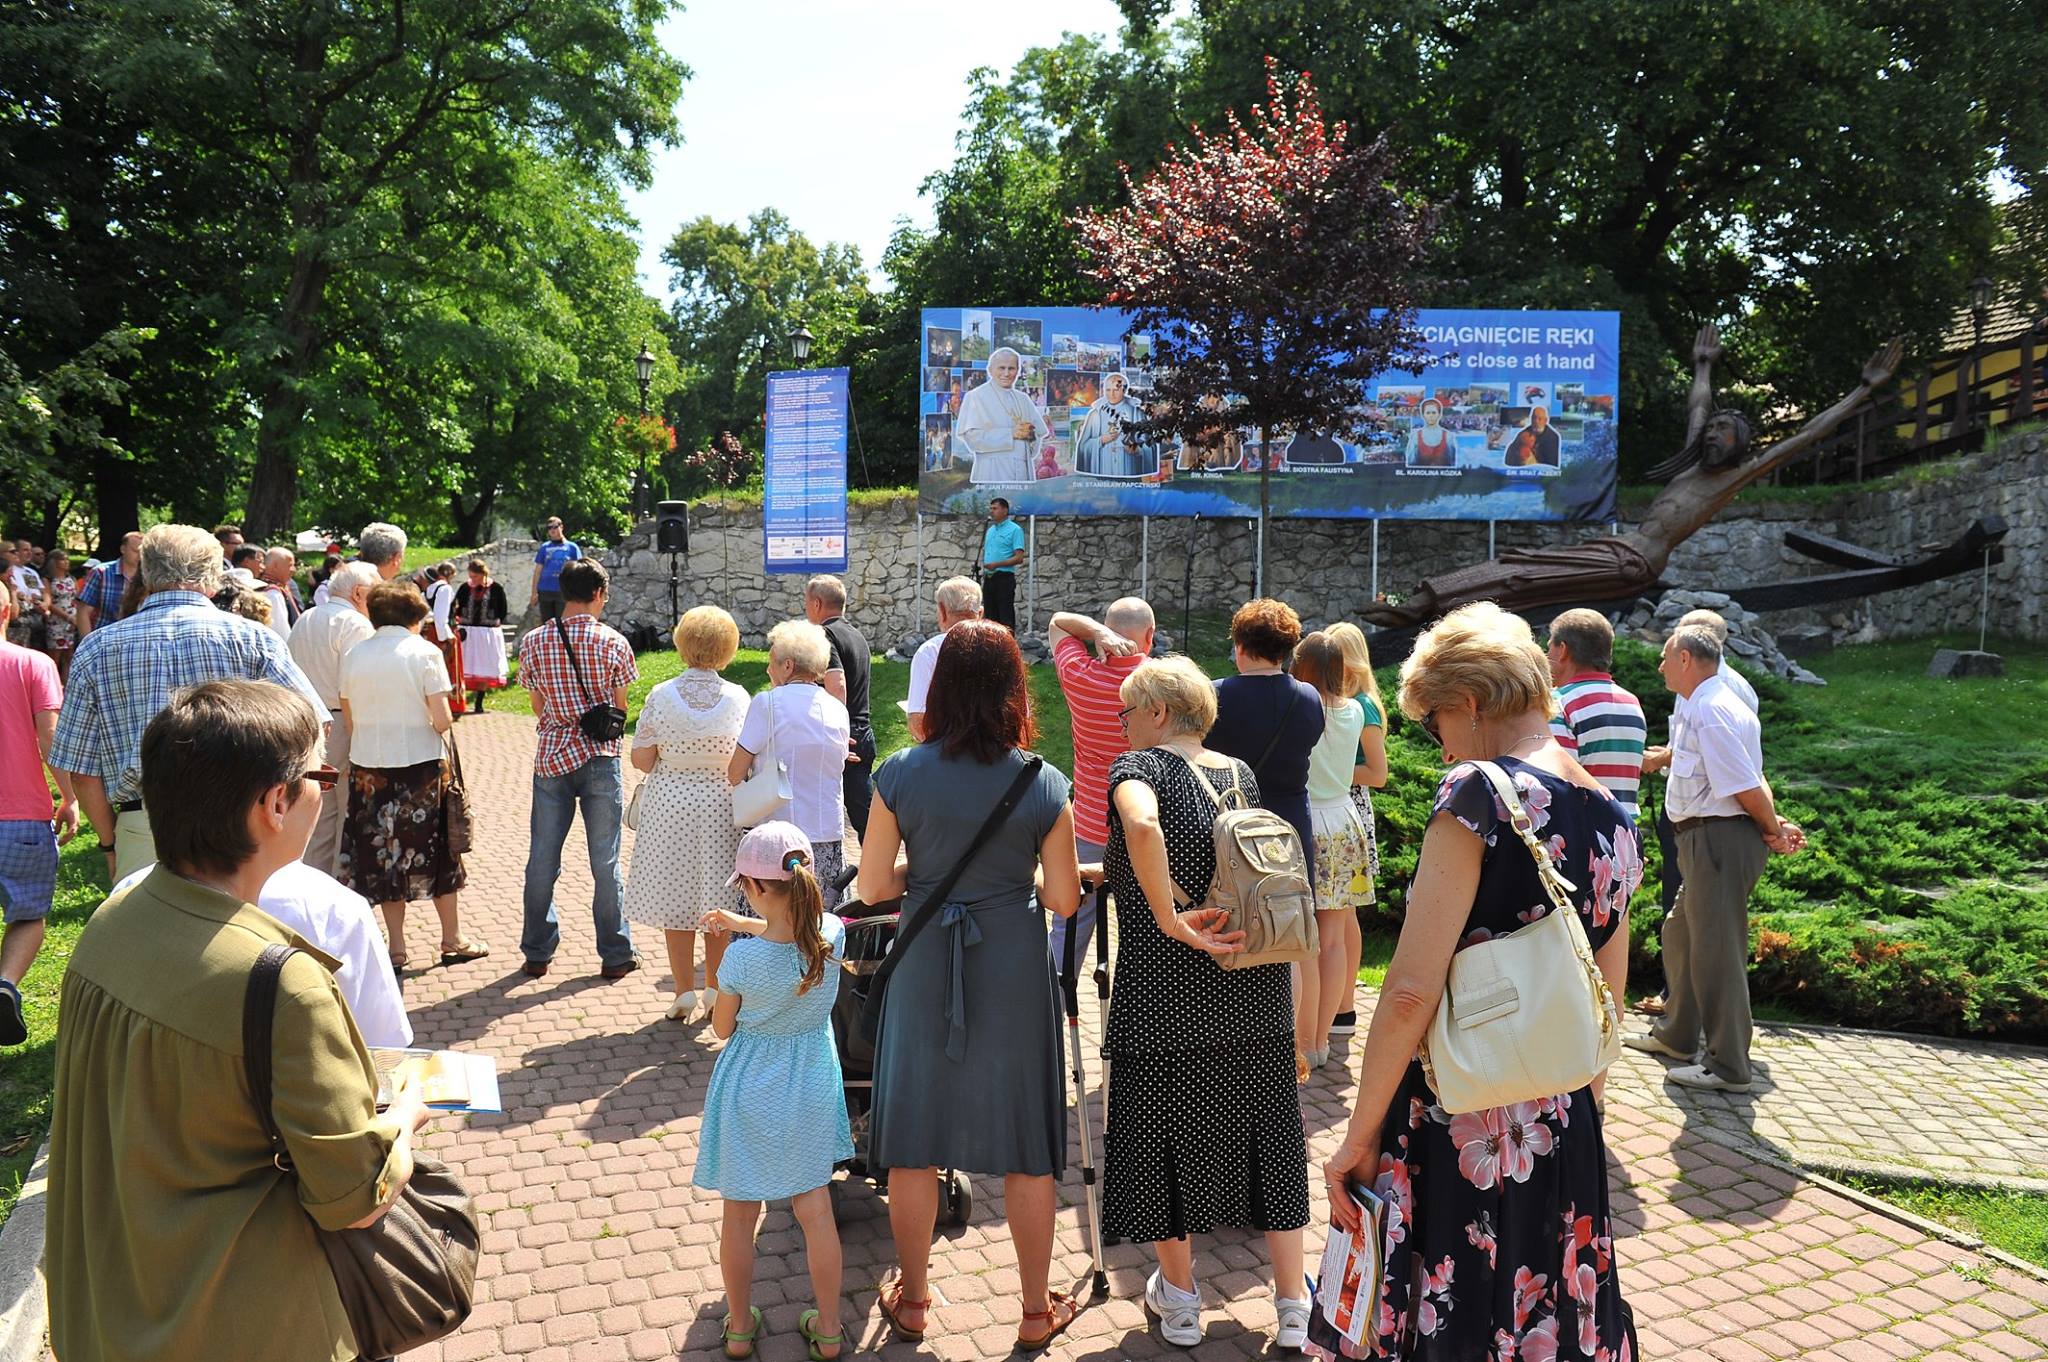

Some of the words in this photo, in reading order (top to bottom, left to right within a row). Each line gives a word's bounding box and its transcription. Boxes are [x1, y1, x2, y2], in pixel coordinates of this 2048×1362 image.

[1546, 327, 1594, 348] RĘKI
[1444, 352, 1461, 368] is
[1467, 351, 1518, 369] close
[1523, 354, 1542, 369] at
[1547, 353, 1595, 370] hand
[1440, 469, 1462, 477] KÓZKA
